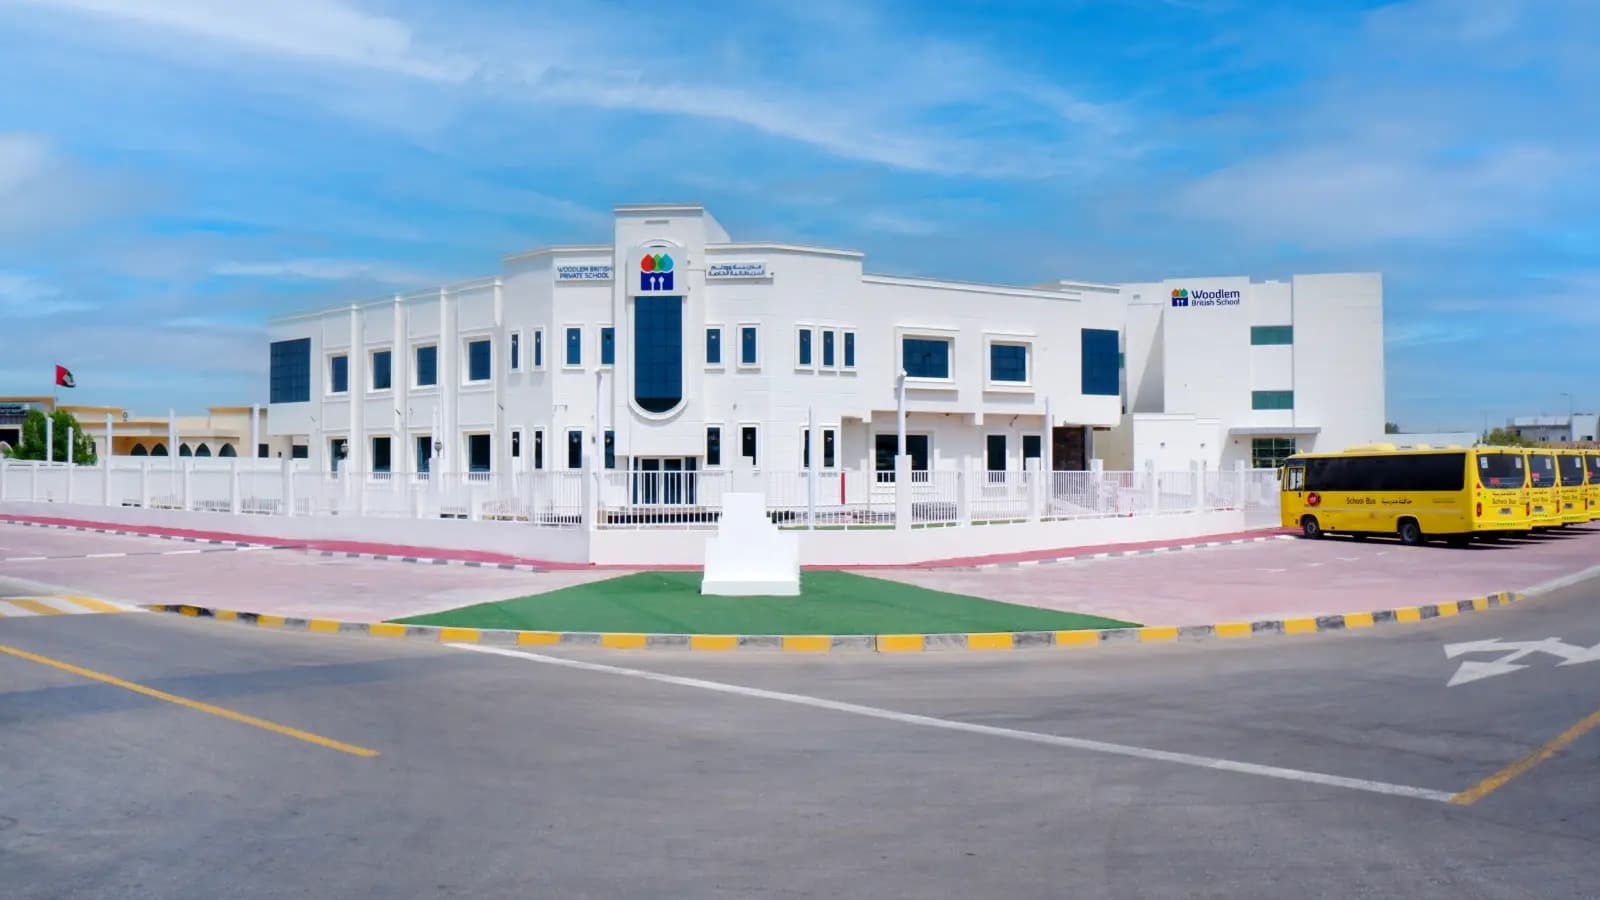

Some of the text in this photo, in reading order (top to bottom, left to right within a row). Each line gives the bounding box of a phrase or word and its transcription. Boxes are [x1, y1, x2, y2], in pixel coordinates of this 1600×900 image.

[1191, 289, 1240, 299] Woodlem
[1216, 298, 1240, 306] School
[1346, 496, 1376, 505] School Bus
